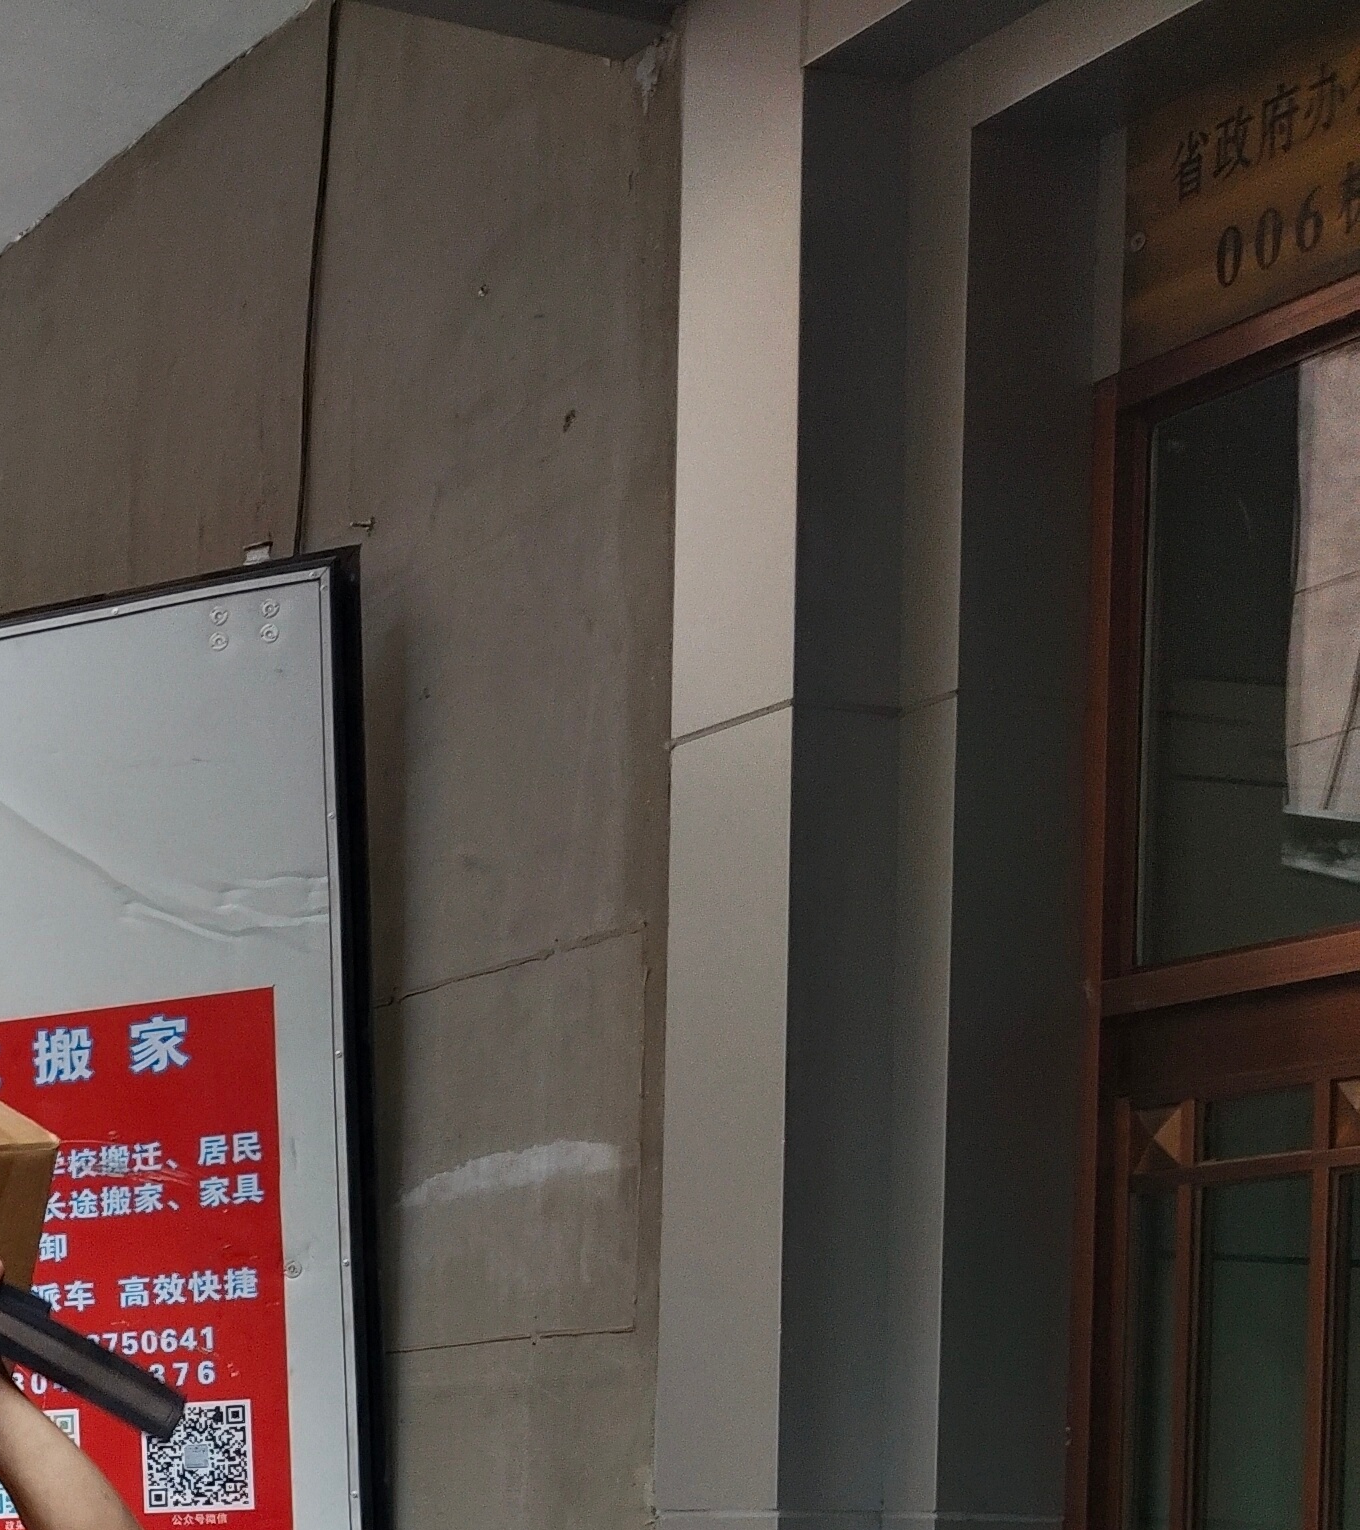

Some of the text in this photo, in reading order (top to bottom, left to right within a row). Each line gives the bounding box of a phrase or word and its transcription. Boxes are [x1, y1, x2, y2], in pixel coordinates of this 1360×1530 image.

[1173, 62, 1360, 200] 省政府办
[117, 1267, 259, 1309] 高效快捷
[171, 1513, 229, 1526] 公众号微信
